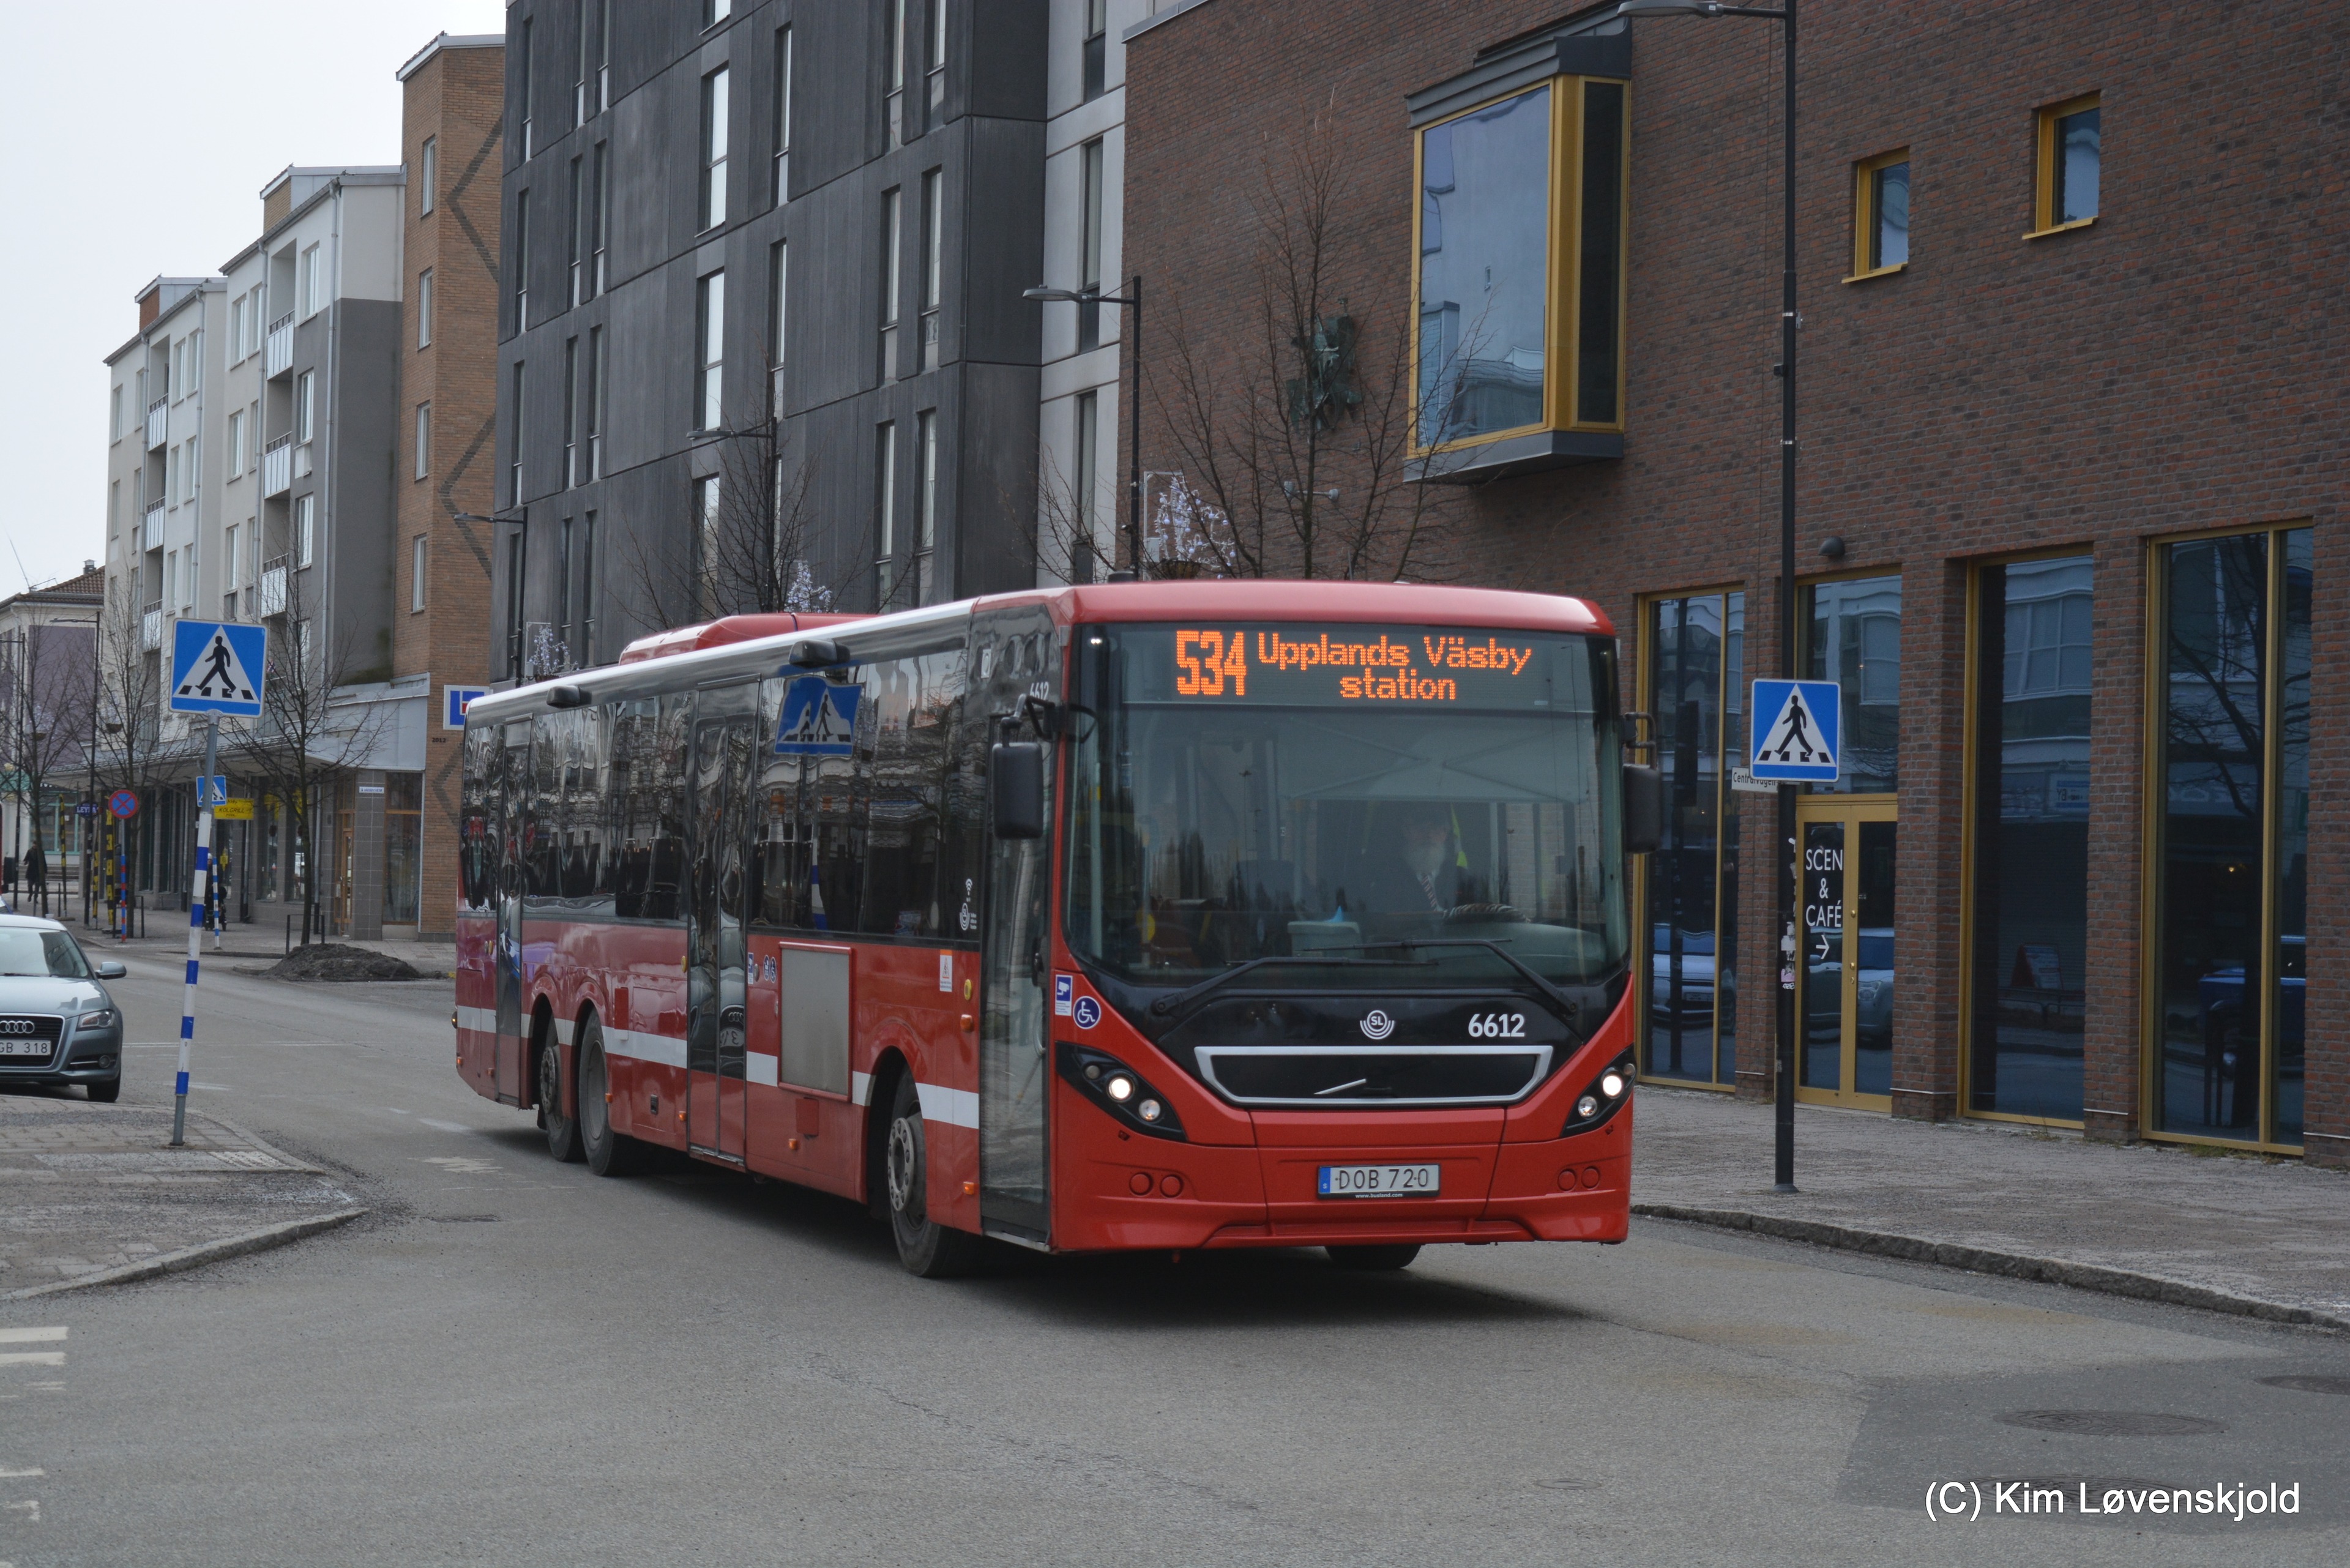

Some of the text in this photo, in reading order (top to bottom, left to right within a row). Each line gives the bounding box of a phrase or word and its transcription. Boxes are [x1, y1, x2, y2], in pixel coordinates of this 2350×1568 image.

[1176, 630, 1247, 695] 534
[1258, 633, 1532, 675] Upplands Väsby
[1030, 681, 1049, 700] 6612
[1340, 668, 1456, 700] station
[1805, 848, 1843, 870] SCEN
[1819, 878, 1829, 898] &
[1805, 900, 1842, 927] CAFÉ
[1370, 1016, 1384, 1026] SL
[1468, 1014, 1525, 1037] 6612
[24, 1042, 48, 1053] 318
[1338, 1168, 1428, 1190] DOB 720
